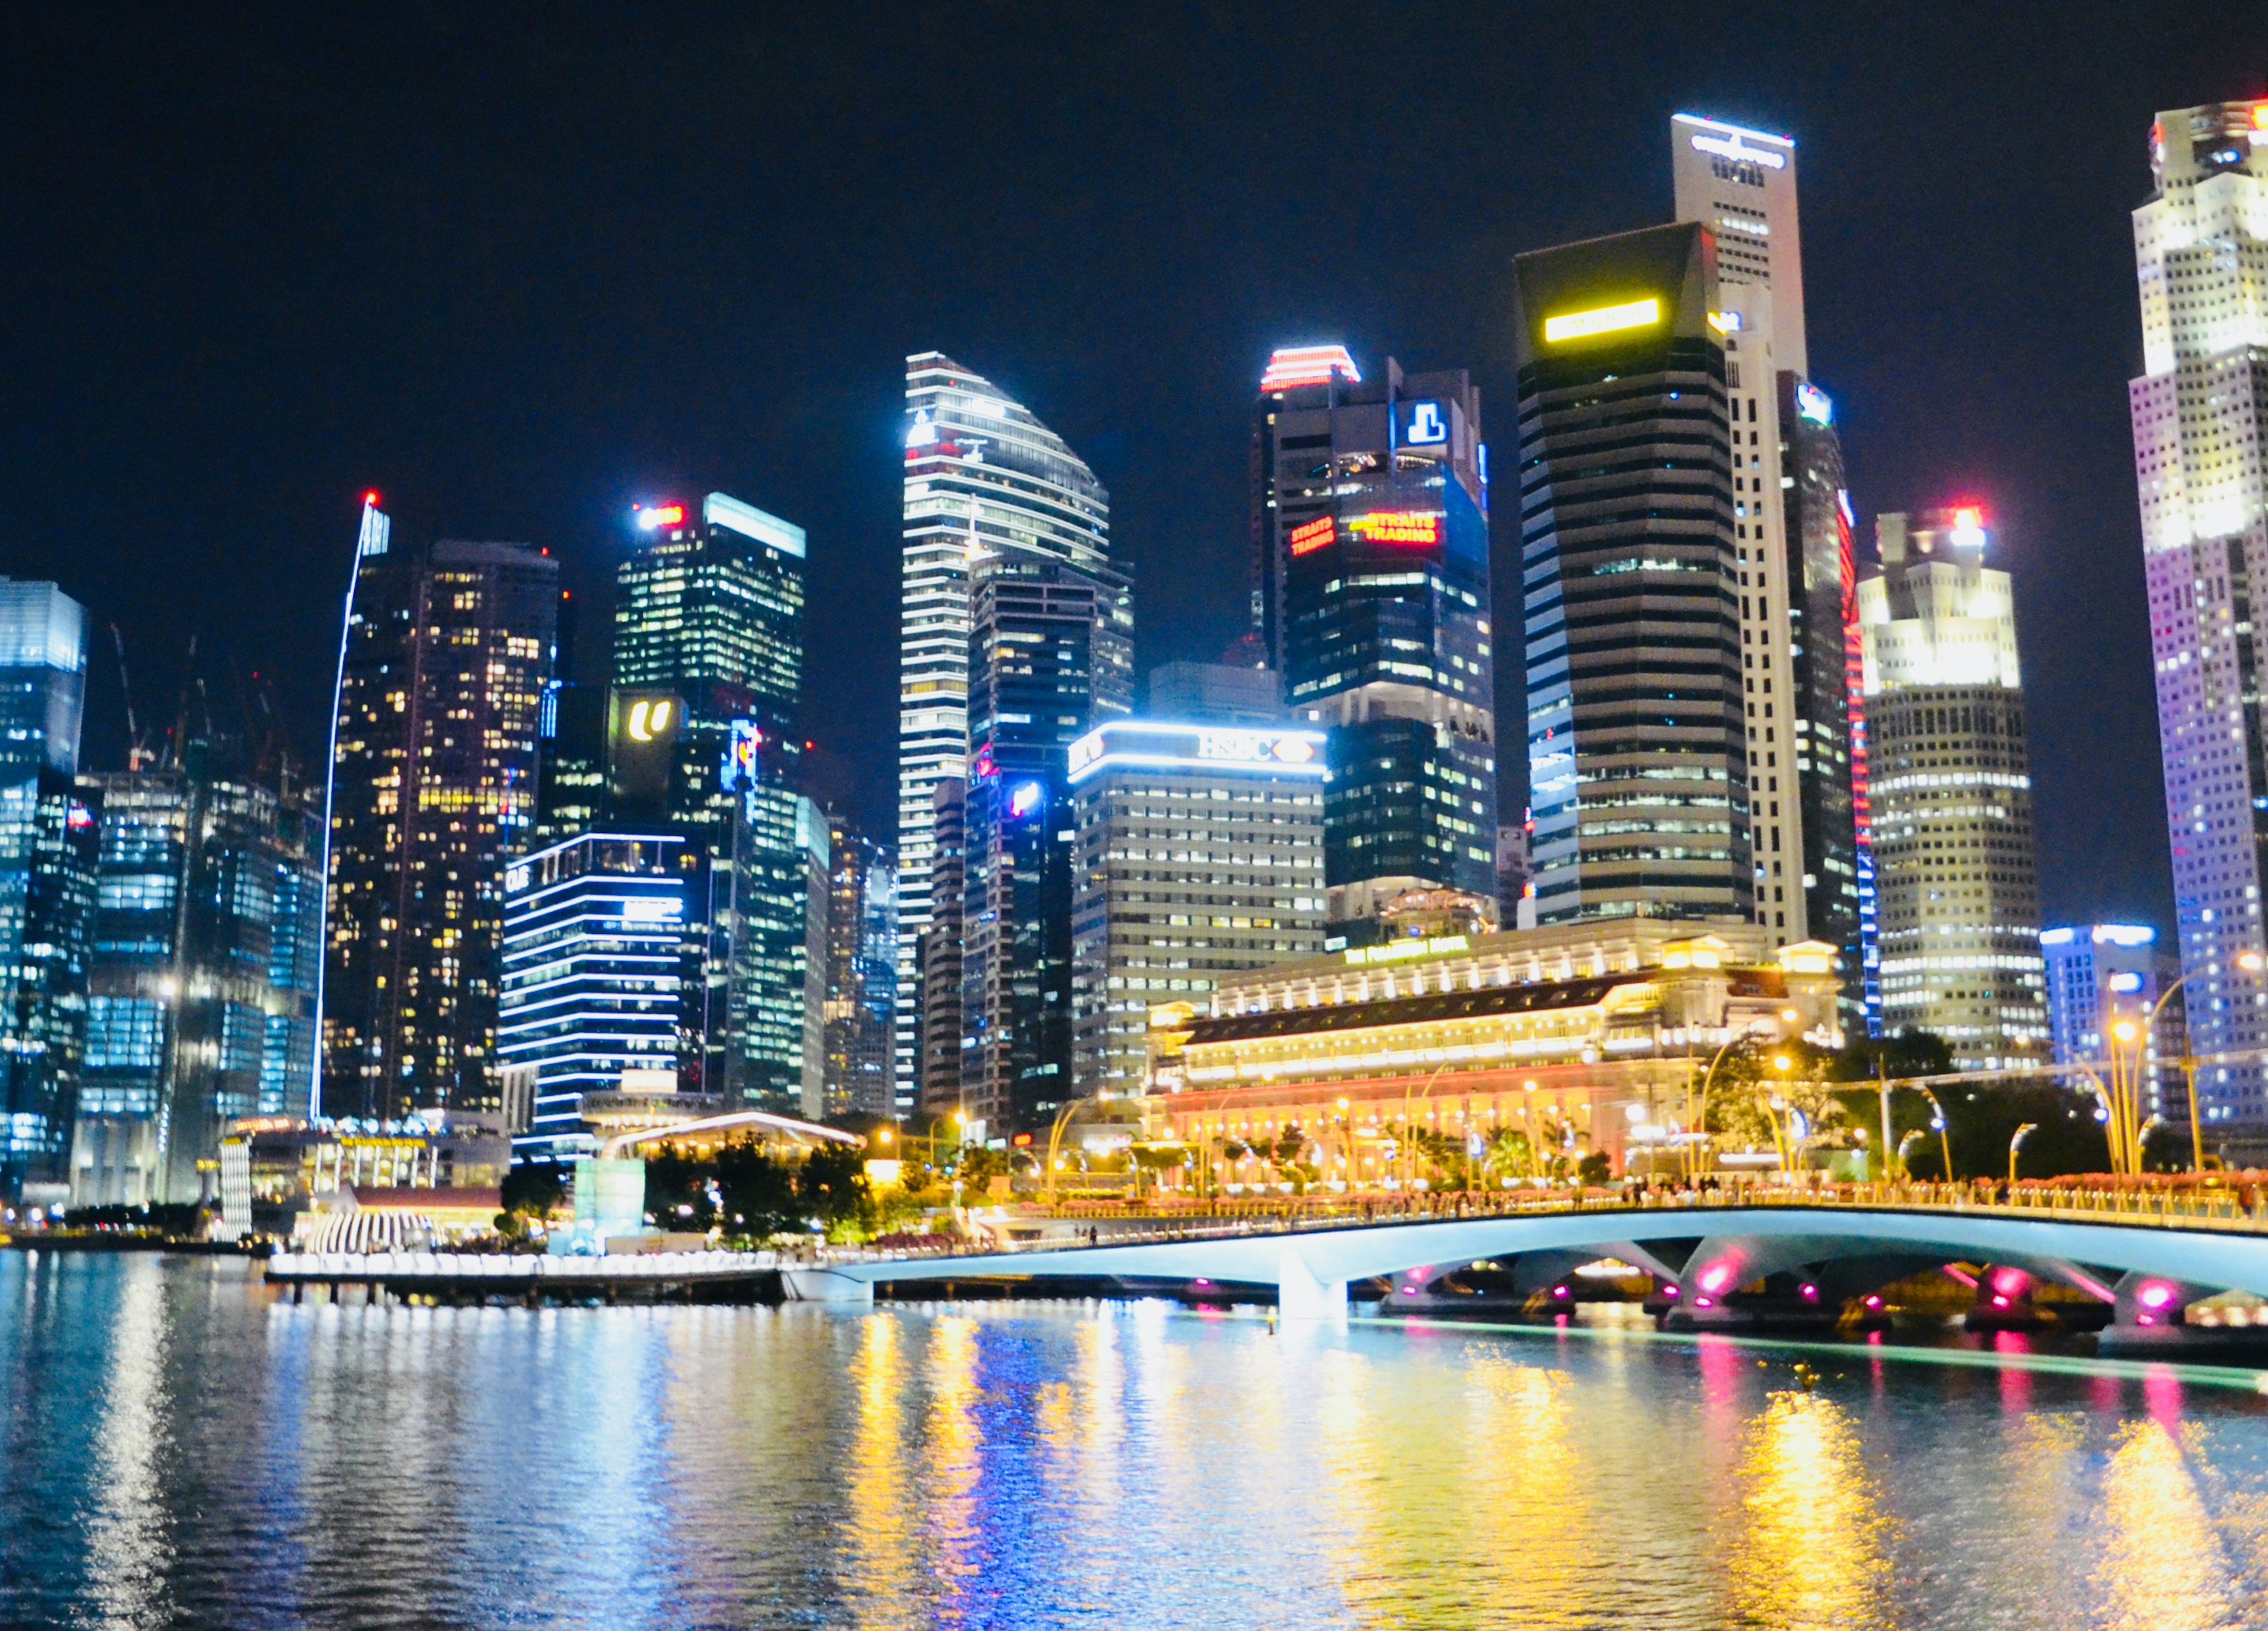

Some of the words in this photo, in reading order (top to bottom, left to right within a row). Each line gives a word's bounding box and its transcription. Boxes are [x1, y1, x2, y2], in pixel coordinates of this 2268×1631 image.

[1291, 515, 1332, 542] STRAITS
[1366, 512, 1435, 529] STRAITS
[1291, 529, 1335, 556] TRADING
[1364, 527, 1436, 543] TRADING
[1198, 733, 1272, 761] HSBC
[1367, 940, 1428, 962] FULLN
[1429, 935, 1469, 953] HOTEL
